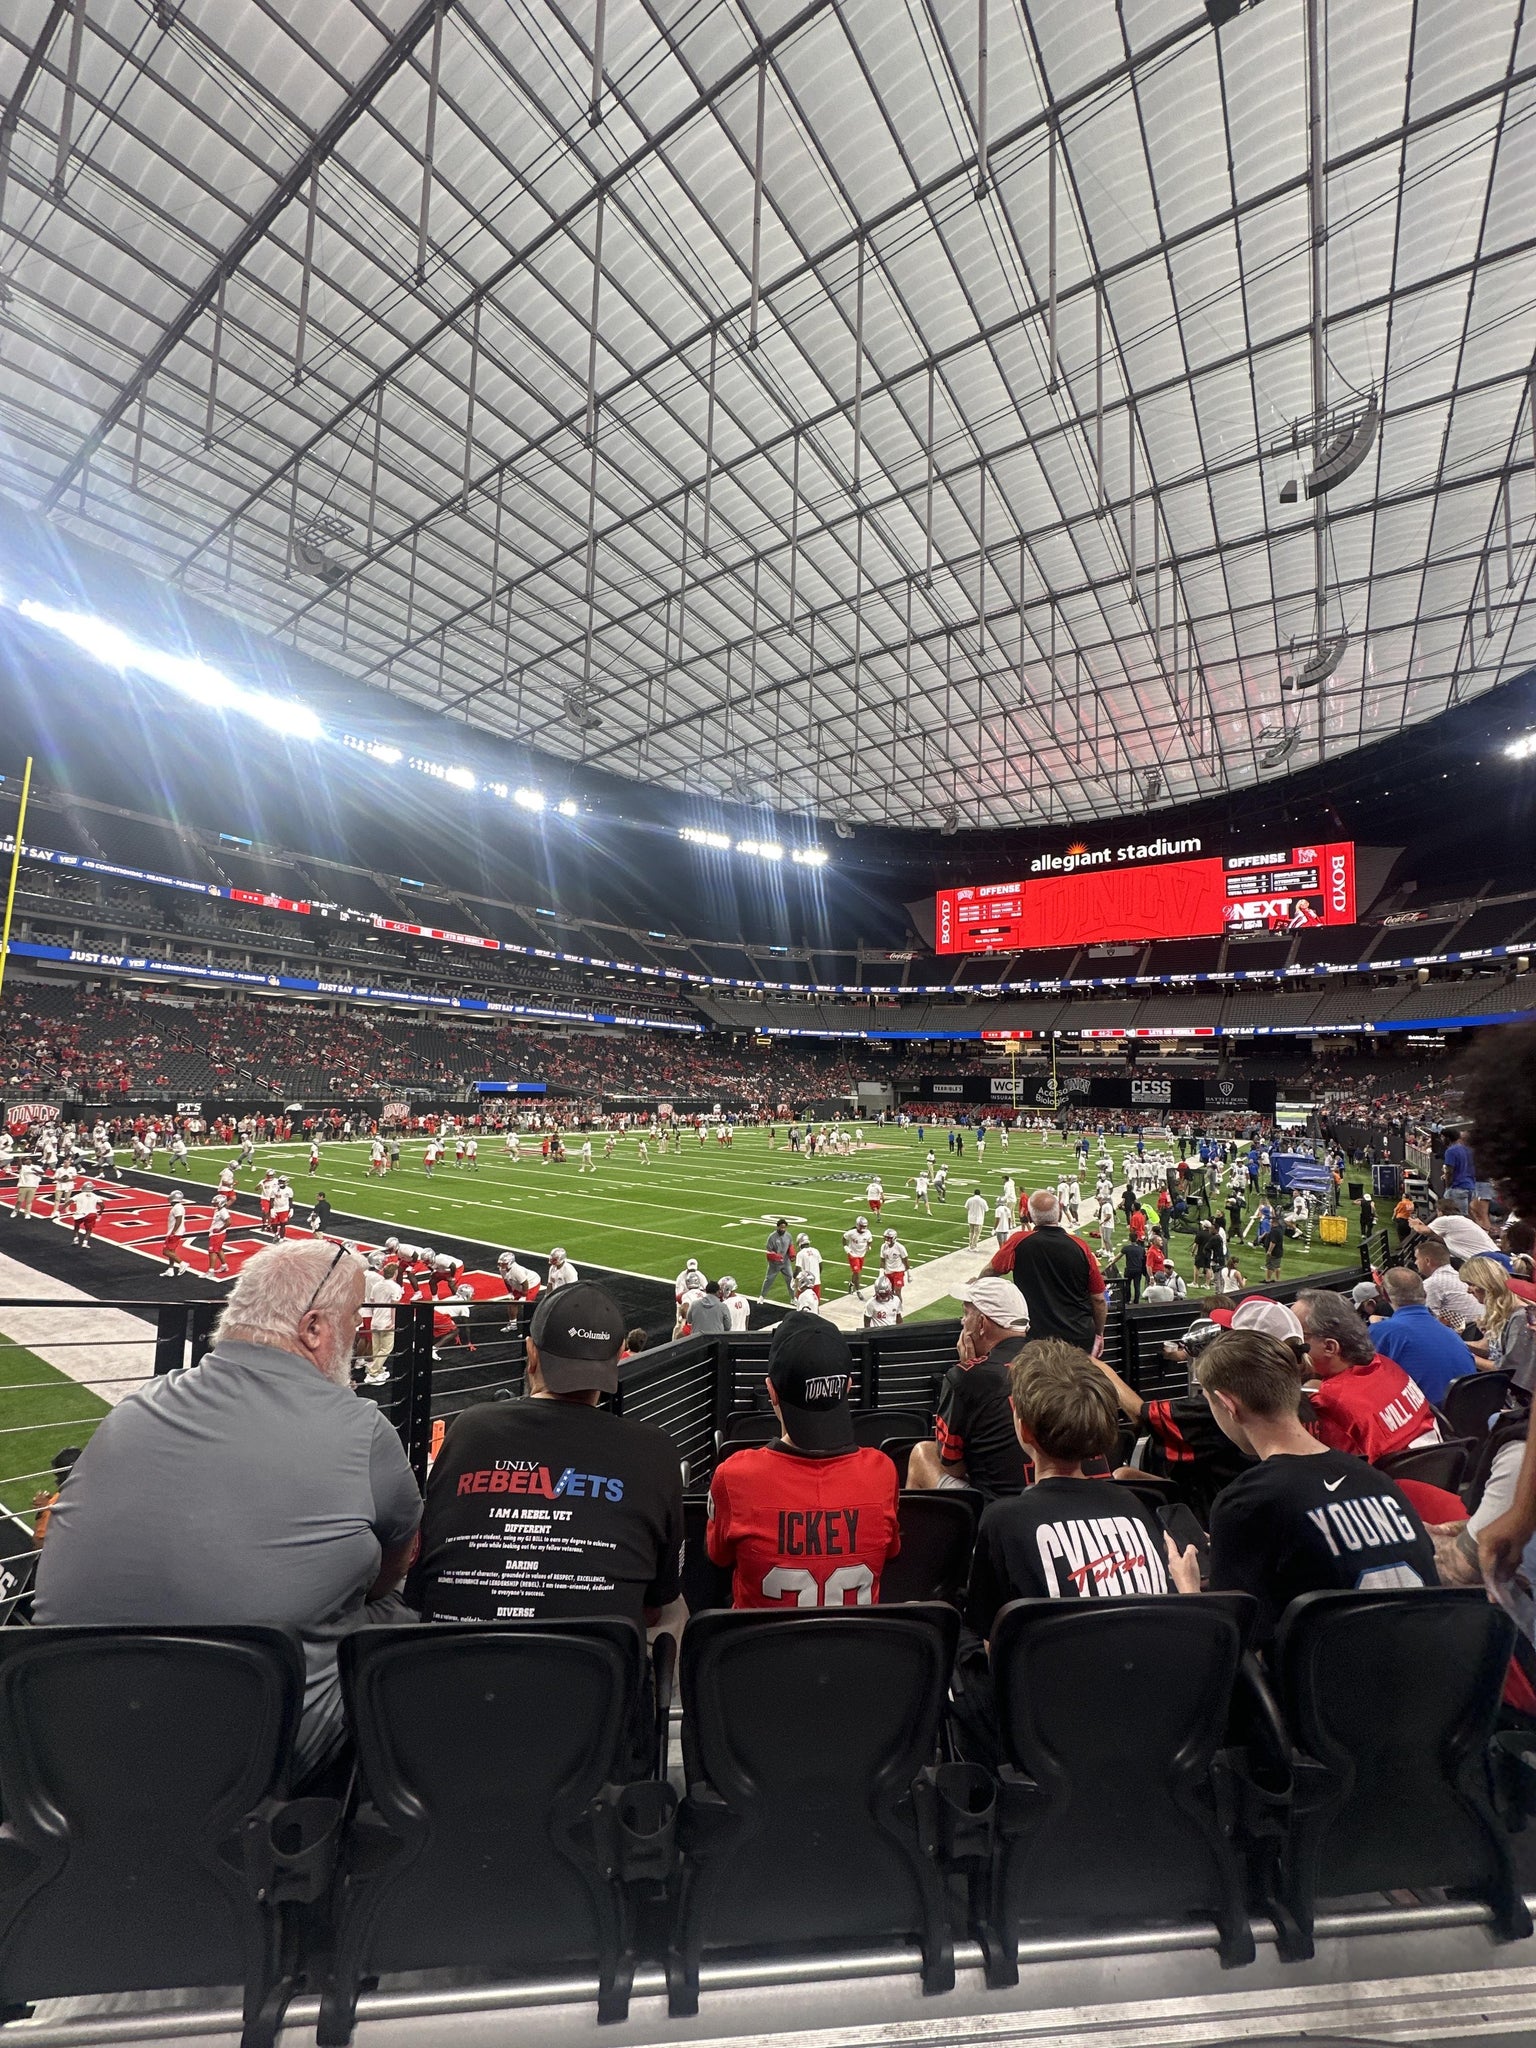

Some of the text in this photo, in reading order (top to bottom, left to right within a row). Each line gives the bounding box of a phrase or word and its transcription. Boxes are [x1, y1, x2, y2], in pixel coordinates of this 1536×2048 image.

[0, 841, 29, 855] JUT
[29, 849, 54, 861] SAY
[1030, 838, 1201, 872] allegiant stadium
[1228, 852, 1286, 868] OFFENSE
[980, 884, 1020, 896] OFFENSE
[1331, 855, 1347, 912] BOYD
[1232, 898, 1292, 920] NEXT
[941, 900, 951, 944] BOYD
[1383, 911, 1421, 926] Coca-Cola
[69, 951, 100, 964] JUST
[101, 954, 125, 966] SAY
[318, 983, 337, 993] JUST
[337, 984, 353, 994] SAY
[993, 1081, 1021, 1091] WCF
[1131, 1080, 1171, 1094] CESS
[577, 1328, 610, 1340] Columbia
[1379, 1398, 1413, 1432] WILL
[495, 1460, 539, 1471] UNLV
[489, 1508, 573, 1521] I AM A REBEL VET
[504, 1524, 552, 1534] DIFFERENT
[778, 1508, 859, 1556] ICKEY
[1306, 1494, 1416, 1557] YOUNG
[502, 1542, 520, 1551] looking
[570, 1537, 586, 1546] degree
[505, 1560, 539, 1571] DARING
[1067, 1551, 1145, 1592] Turbo
[477, 1570, 500, 1578] character,
[501, 1571, 525, 1579] grounded
[553, 1574, 575, 1582] RESPECT,
[554, 1582, 591, 1591] team-oriented,
[592, 1583, 614, 1591] dedicated
[496, 1607, 535, 1618] DIVERSE
